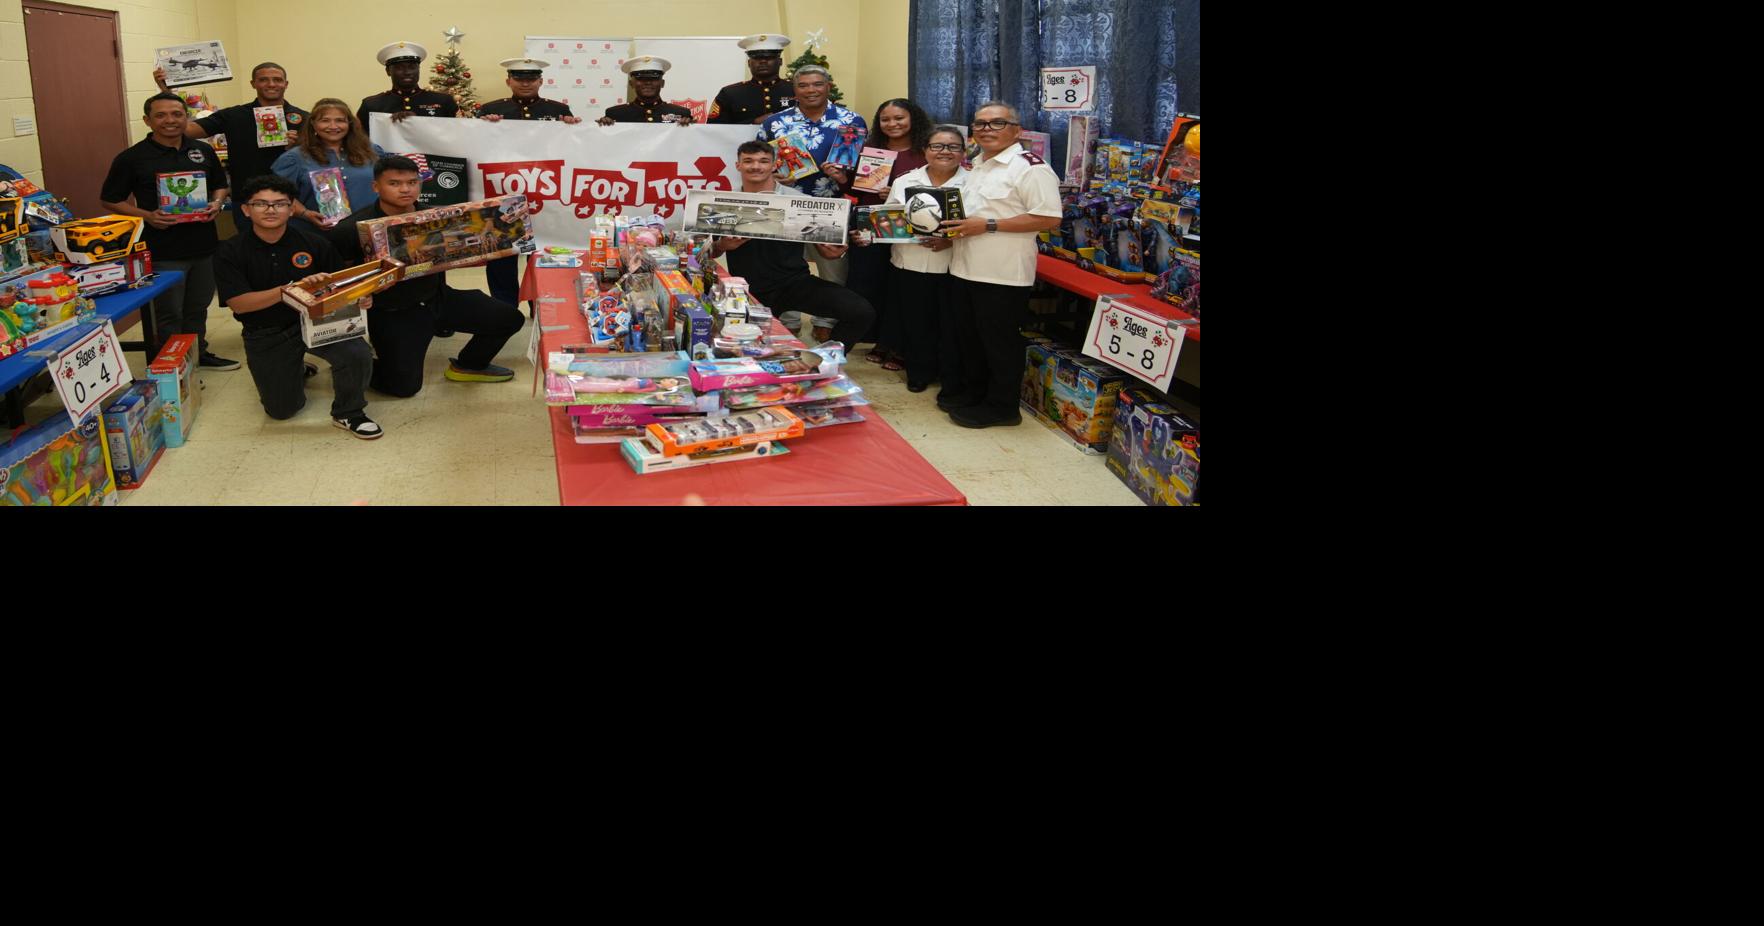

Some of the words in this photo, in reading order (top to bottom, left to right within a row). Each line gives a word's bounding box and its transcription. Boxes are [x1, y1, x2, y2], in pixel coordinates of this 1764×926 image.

[1065, 89, 1077, 103] 8
[486, 167, 557, 196] TOYS
[574, 175, 630, 202] FOR
[791, 199, 836, 210] PREDATOR
[313, 328, 337, 337] AVIATOR
[1123, 316, 1149, 338] Ages
[76, 346, 97, 368] Ages
[1109, 335, 1121, 354] 5
[1141, 349, 1155, 370] 8
[74, 381, 86, 403] 0
[100, 362, 111, 383] 4
[723, 375, 756, 387] Barbie
[592, 404, 625, 415] Barbie
[602, 415, 637, 425] Barbie
